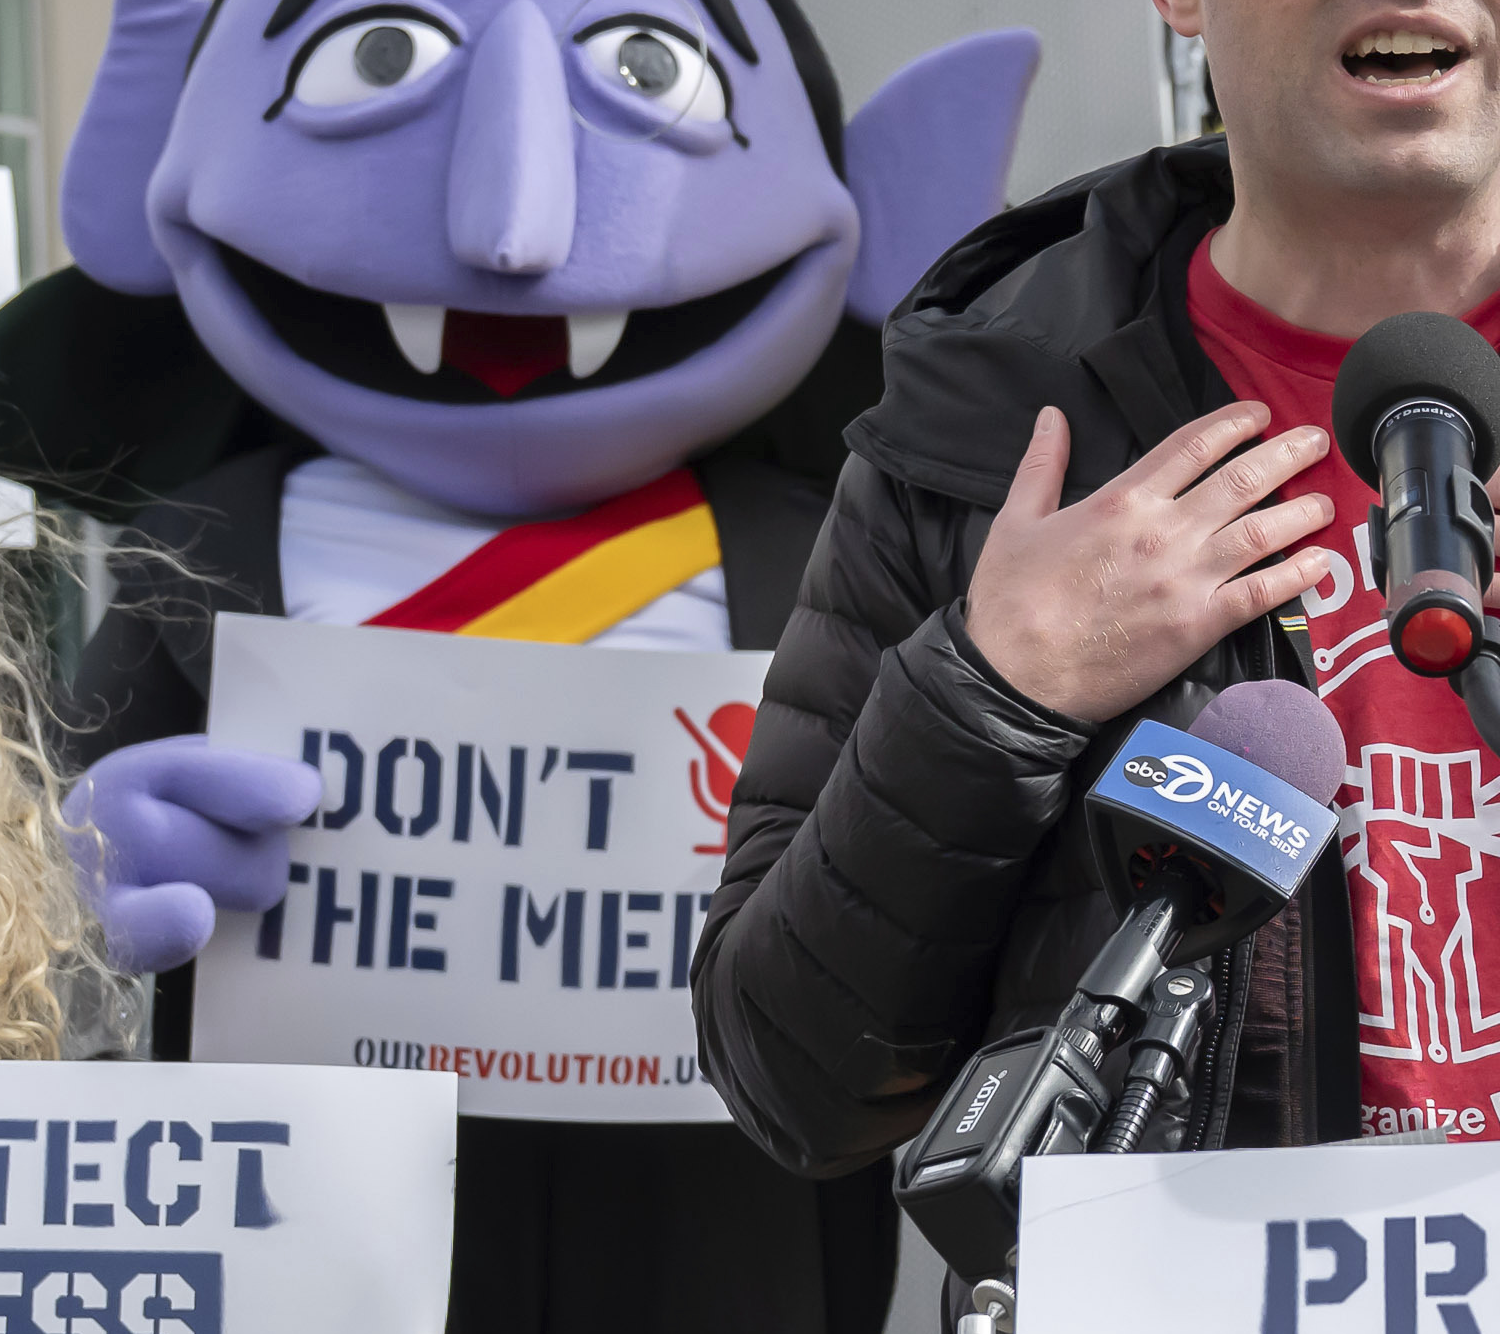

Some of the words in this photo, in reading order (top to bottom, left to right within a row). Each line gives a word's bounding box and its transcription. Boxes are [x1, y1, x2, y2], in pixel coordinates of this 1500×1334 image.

[299, 728, 635, 851] DON'T
[1124, 761, 1167, 783] abc
[1212, 781, 1312, 850] NEWS
[1207, 800, 1229, 818] ON
[1232, 812, 1269, 841] YOUR
[1269, 835, 1301, 860] SIDE
[955, 1070, 1001, 1135] auray
[1361, 1098, 1486, 1137] ganize
